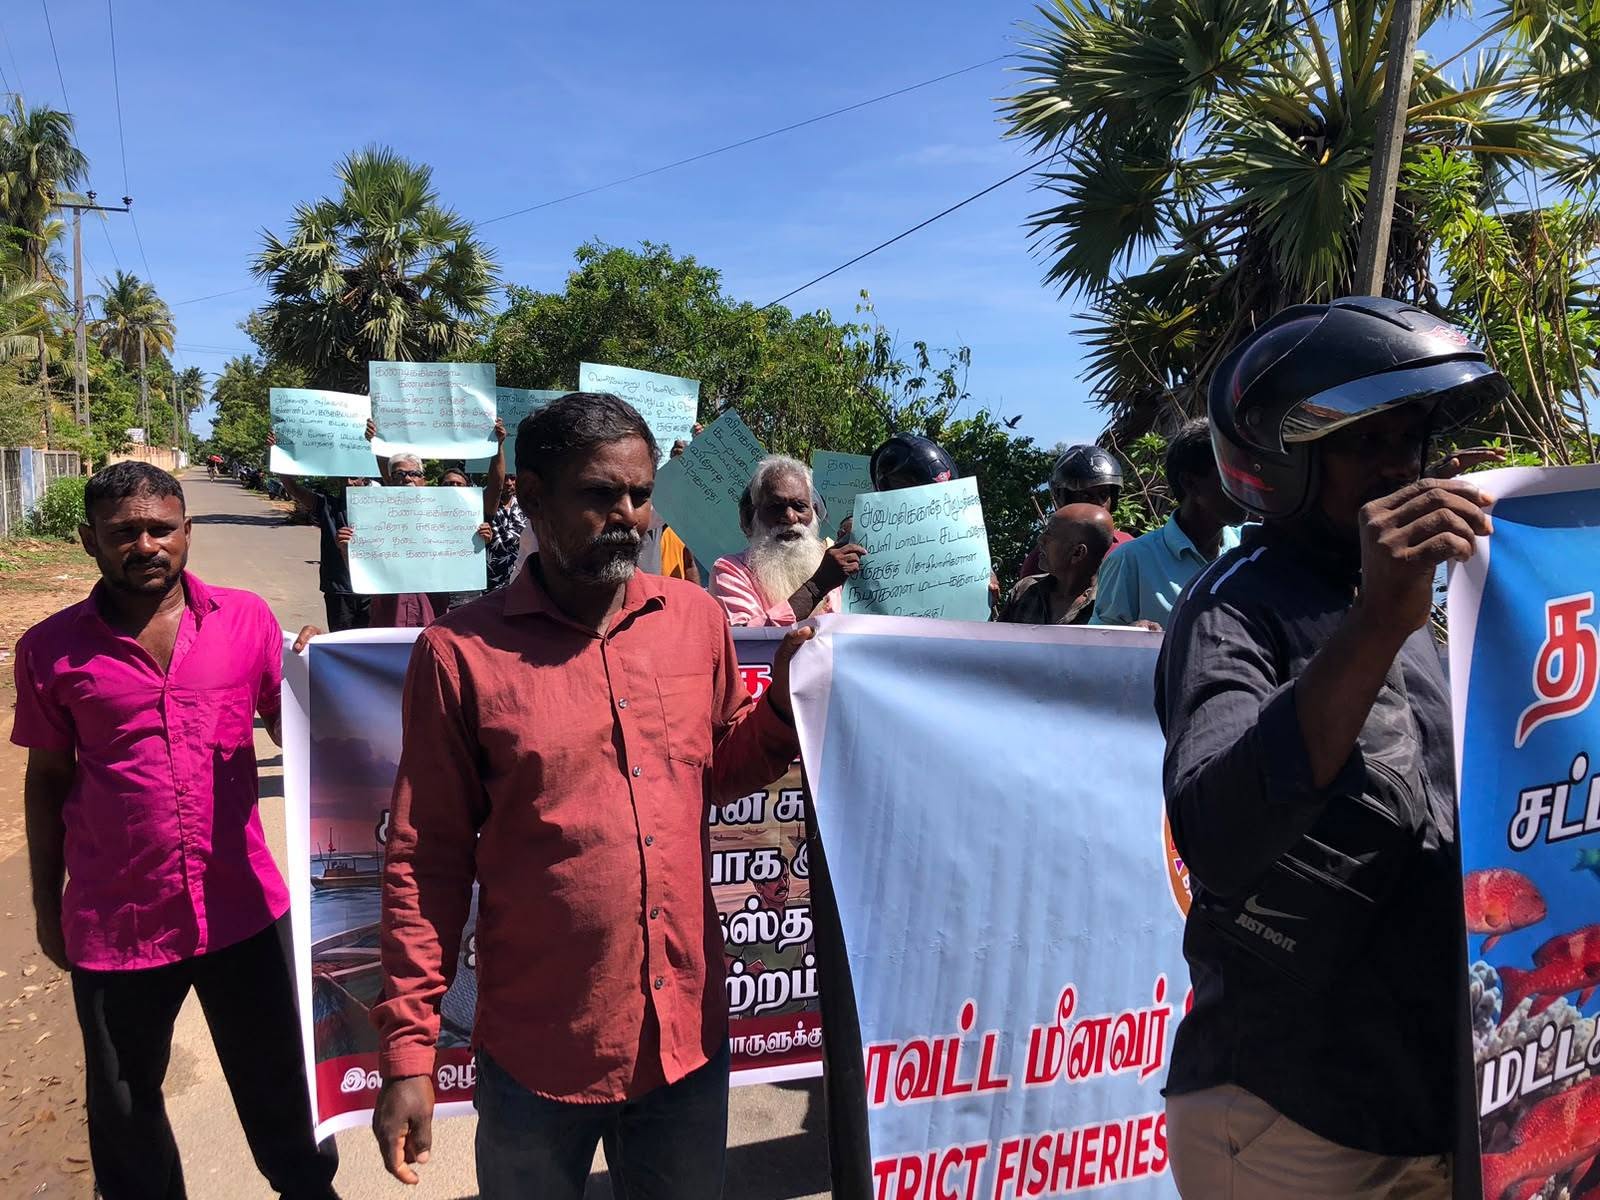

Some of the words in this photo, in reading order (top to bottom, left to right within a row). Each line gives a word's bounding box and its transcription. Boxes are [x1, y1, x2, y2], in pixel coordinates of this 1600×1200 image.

[1235, 912, 1266, 935] JUST
[1263, 926, 1283, 945] DO
[866, 1000, 1010, 1105] ாவட்ட
[1024, 975, 1171, 1085] மீனவர்
[994, 1111, 1170, 1200] FISHERIES
